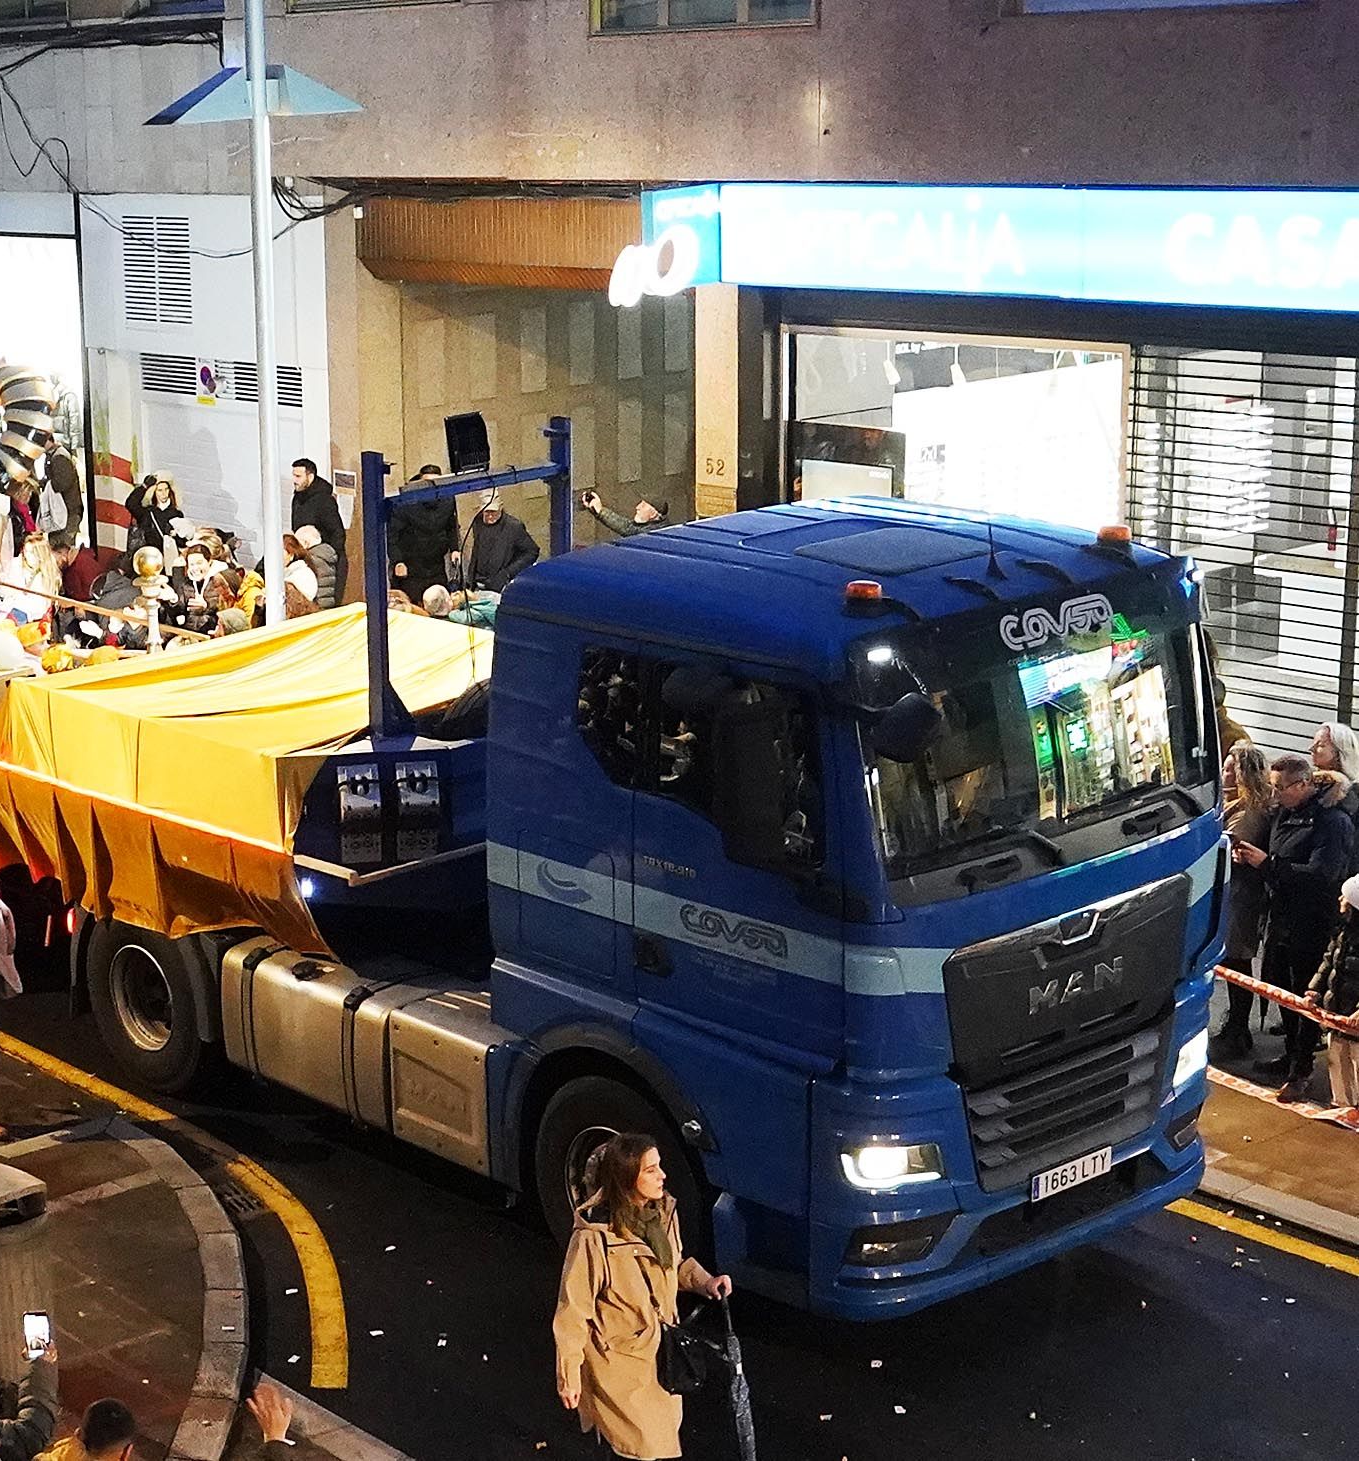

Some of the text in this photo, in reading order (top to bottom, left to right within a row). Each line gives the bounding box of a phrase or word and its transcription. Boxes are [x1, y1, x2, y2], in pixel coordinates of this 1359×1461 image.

[705, 457, 725, 476] 52
[1028, 955, 1123, 1016] MAN
[1044, 1152, 1108, 1192] 1663 LTY
